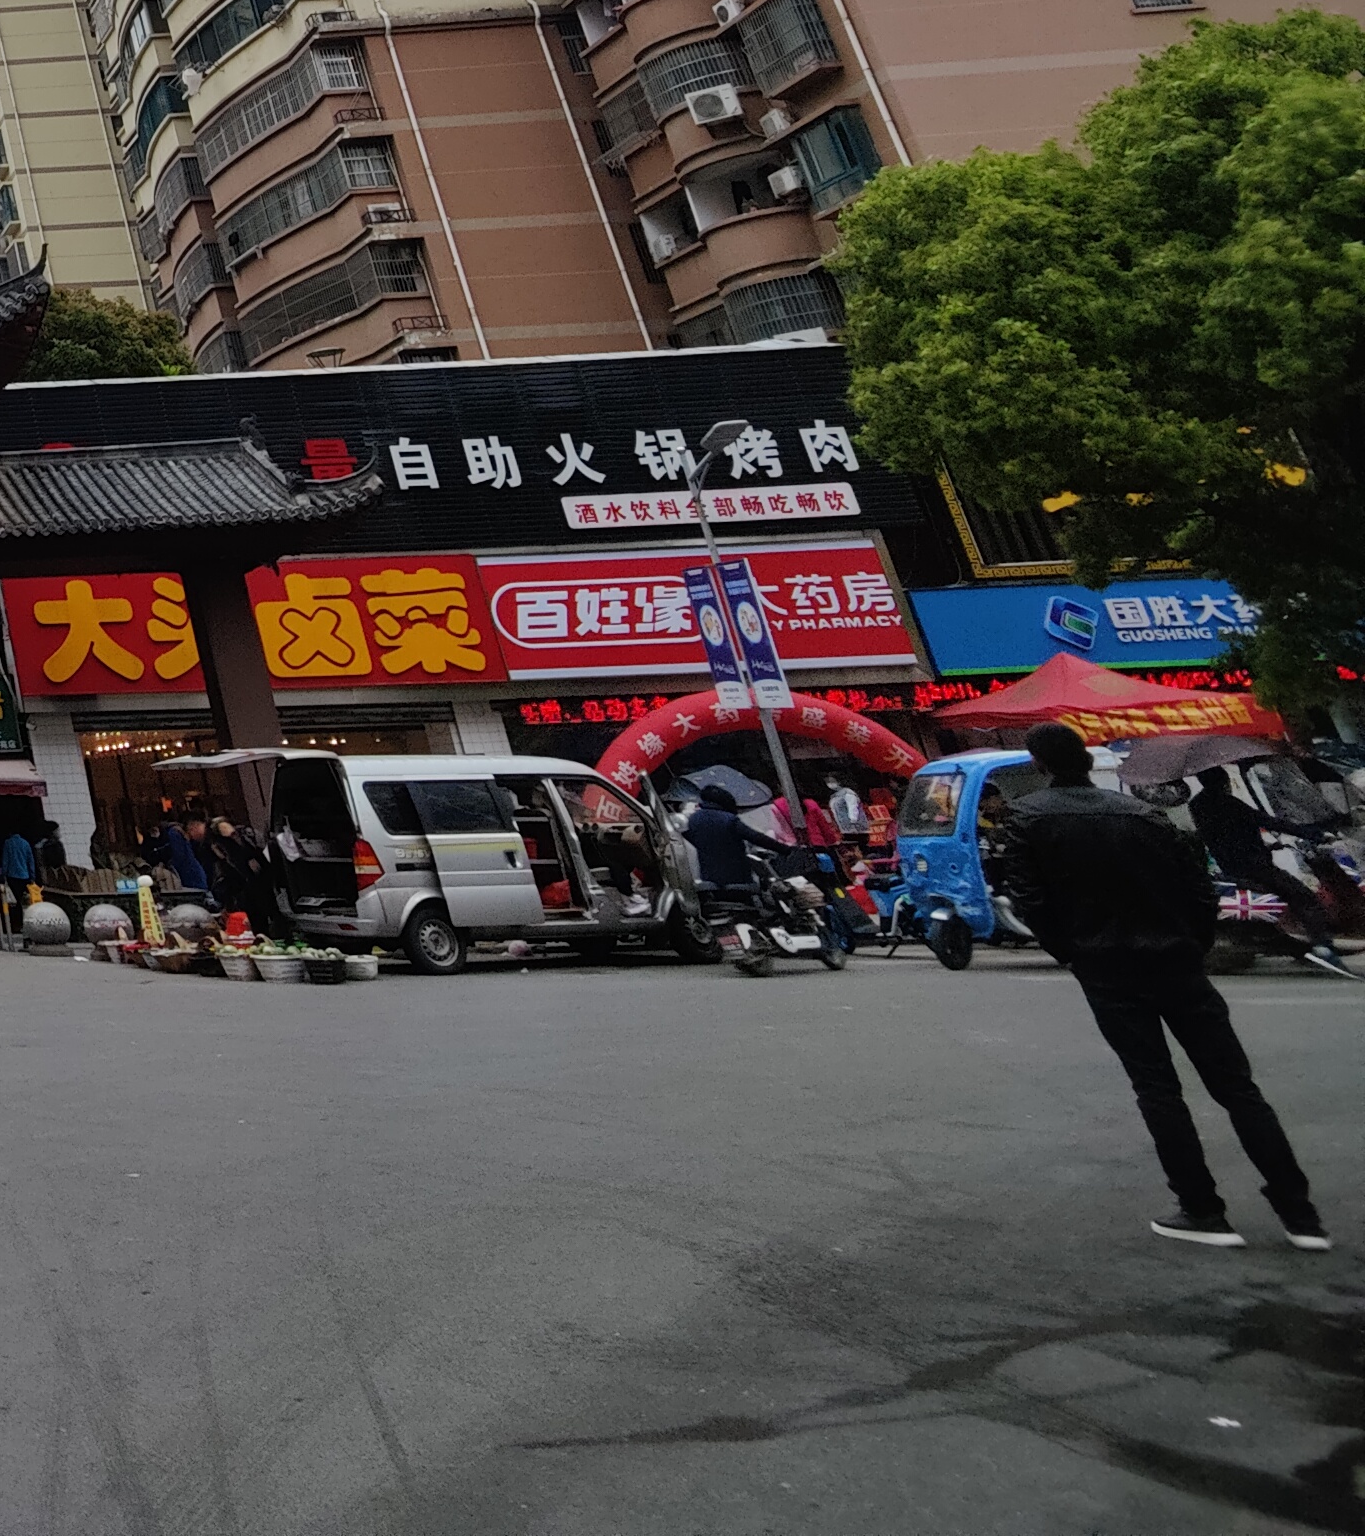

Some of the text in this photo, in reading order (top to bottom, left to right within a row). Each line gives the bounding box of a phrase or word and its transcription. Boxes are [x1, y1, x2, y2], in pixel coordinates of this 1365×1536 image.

[389, 419, 860, 490] 自助火锅烤肉
[574, 490, 850, 524] 酒水饮料全部畅吃畅饮
[515, 585, 693, 638] 百姓缘
[790, 614, 903, 630] PHARMACY
[1118, 626, 1213, 643] GUOSHENG
